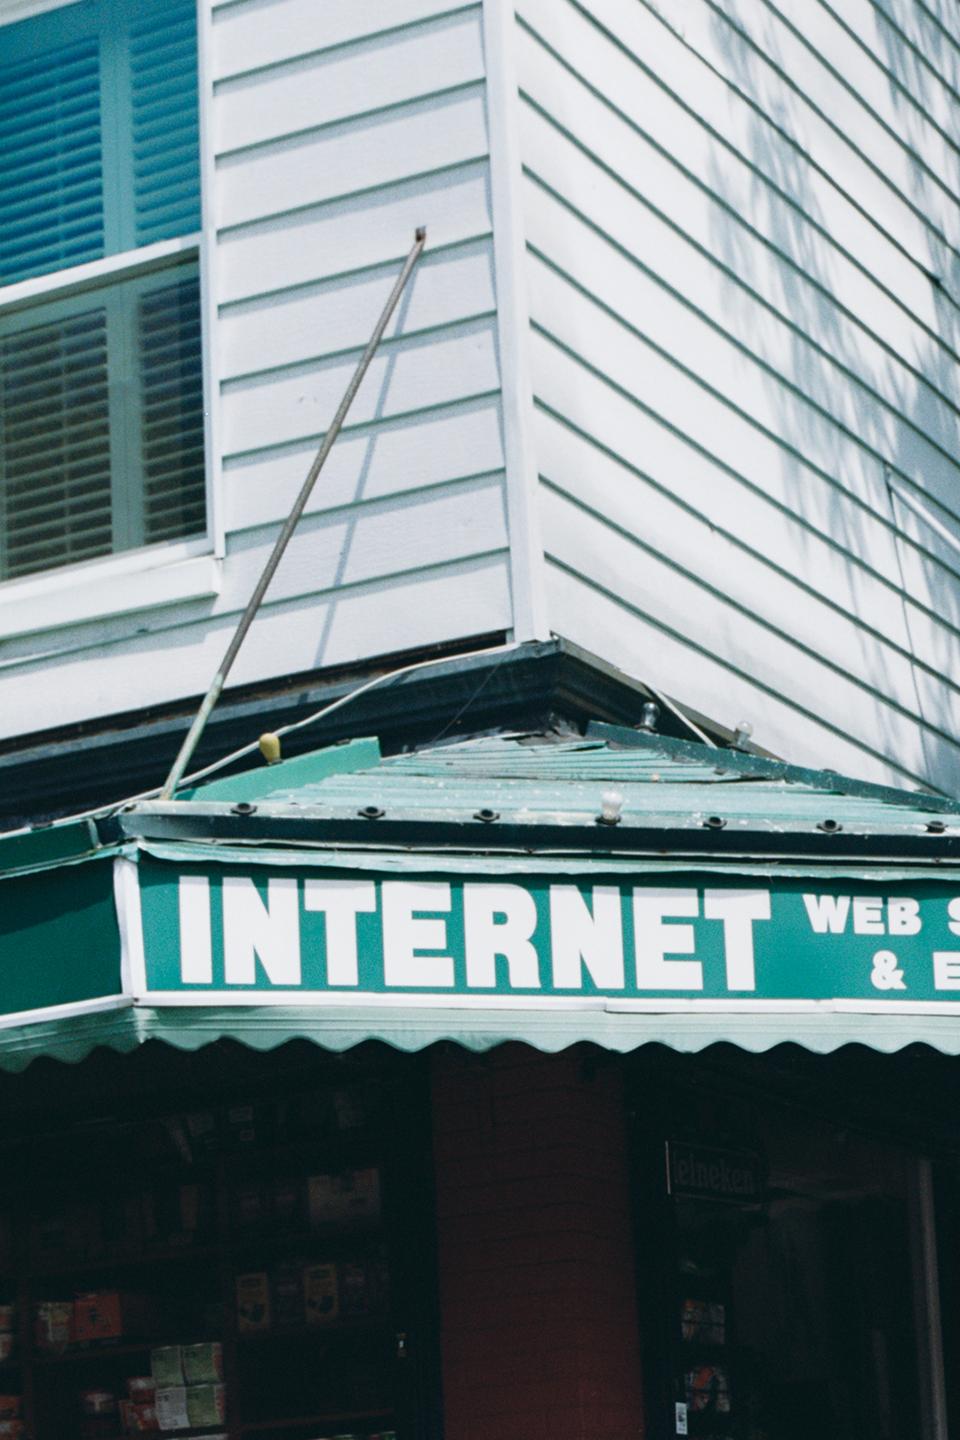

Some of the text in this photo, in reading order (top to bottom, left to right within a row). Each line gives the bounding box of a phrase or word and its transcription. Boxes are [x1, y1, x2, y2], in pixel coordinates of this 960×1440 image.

[178, 875, 771, 992] INTERNET
[802, 893, 923, 936] WEB
[870, 950, 907, 991] &
